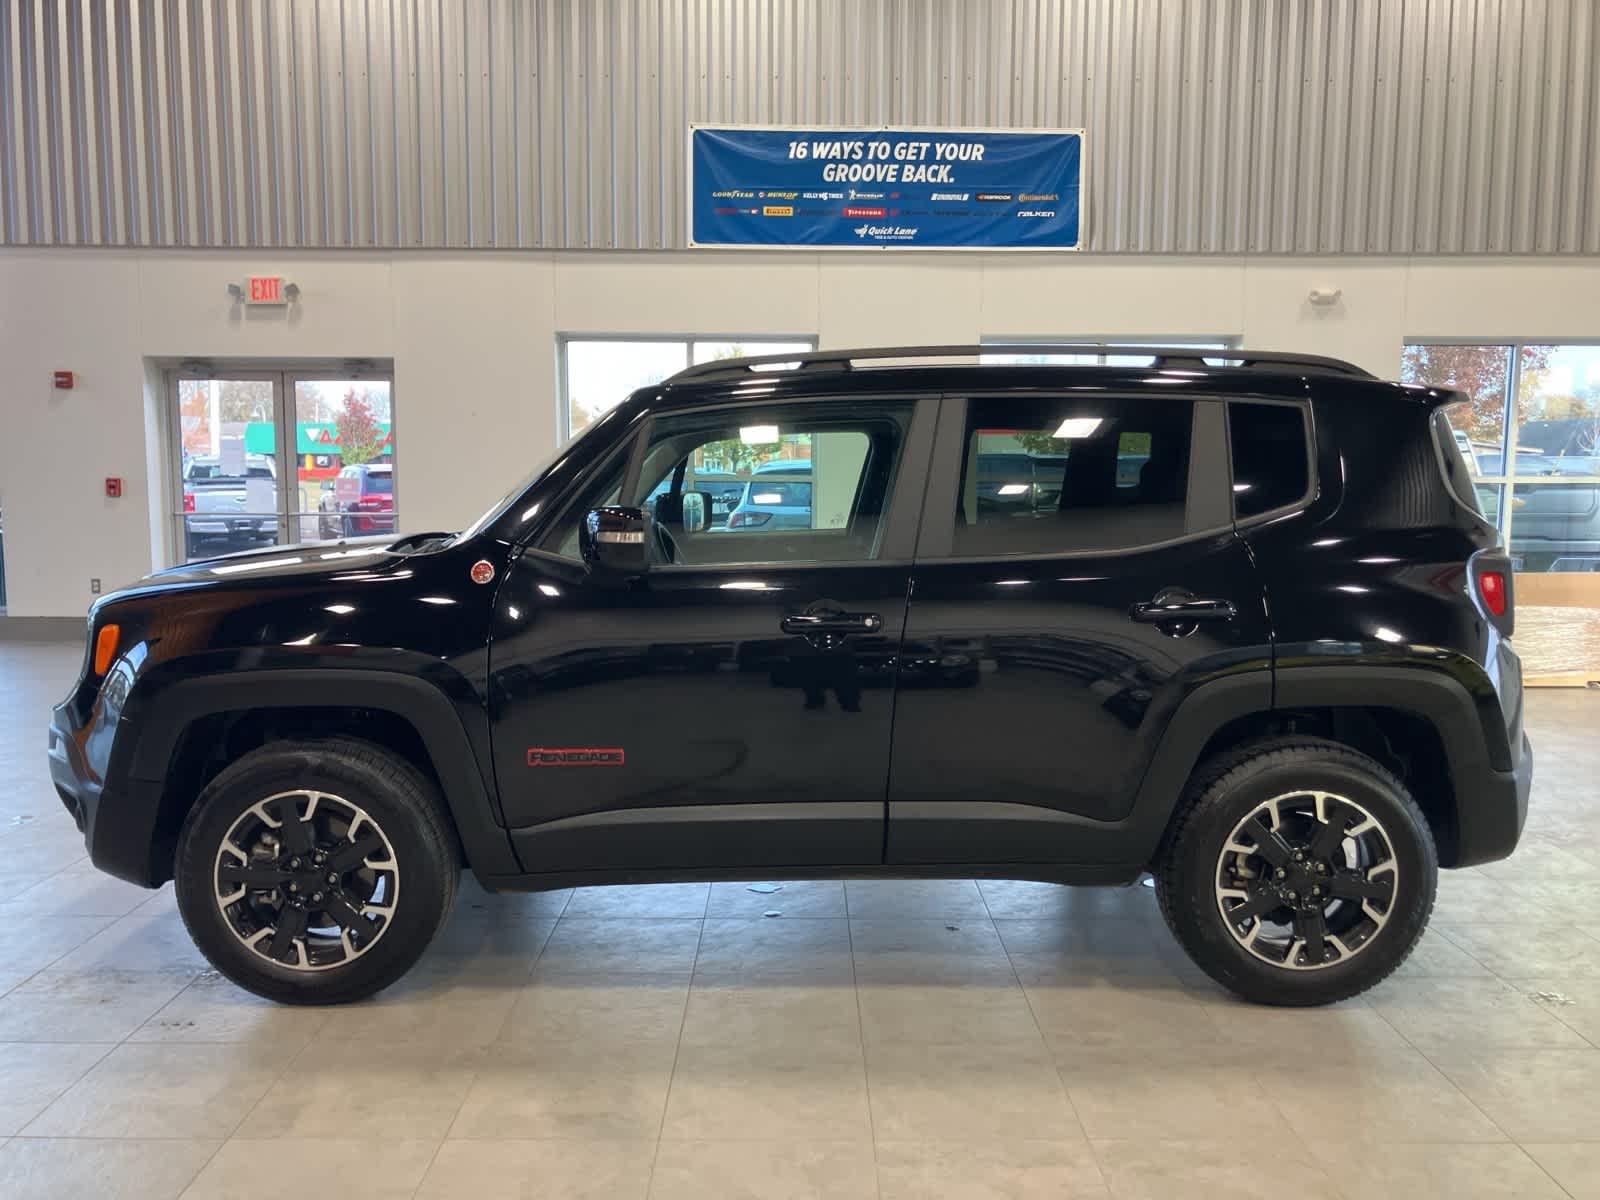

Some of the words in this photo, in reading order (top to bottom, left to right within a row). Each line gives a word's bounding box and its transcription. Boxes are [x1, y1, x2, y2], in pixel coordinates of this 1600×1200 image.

[788, 142, 808, 159] 16
[812, 142, 864, 160] WAYS
[868, 142, 891, 160] TO
[894, 142, 930, 160] GET
[935, 143, 985, 161] YOUR
[823, 164, 899, 182] GROOVE
[901, 164, 955, 183] BACK.
[868, 226, 893, 236] Quick
[894, 226, 918, 235] Lane
[251, 278, 281, 301] EXIT
[529, 750, 623, 764] RENEGADE
